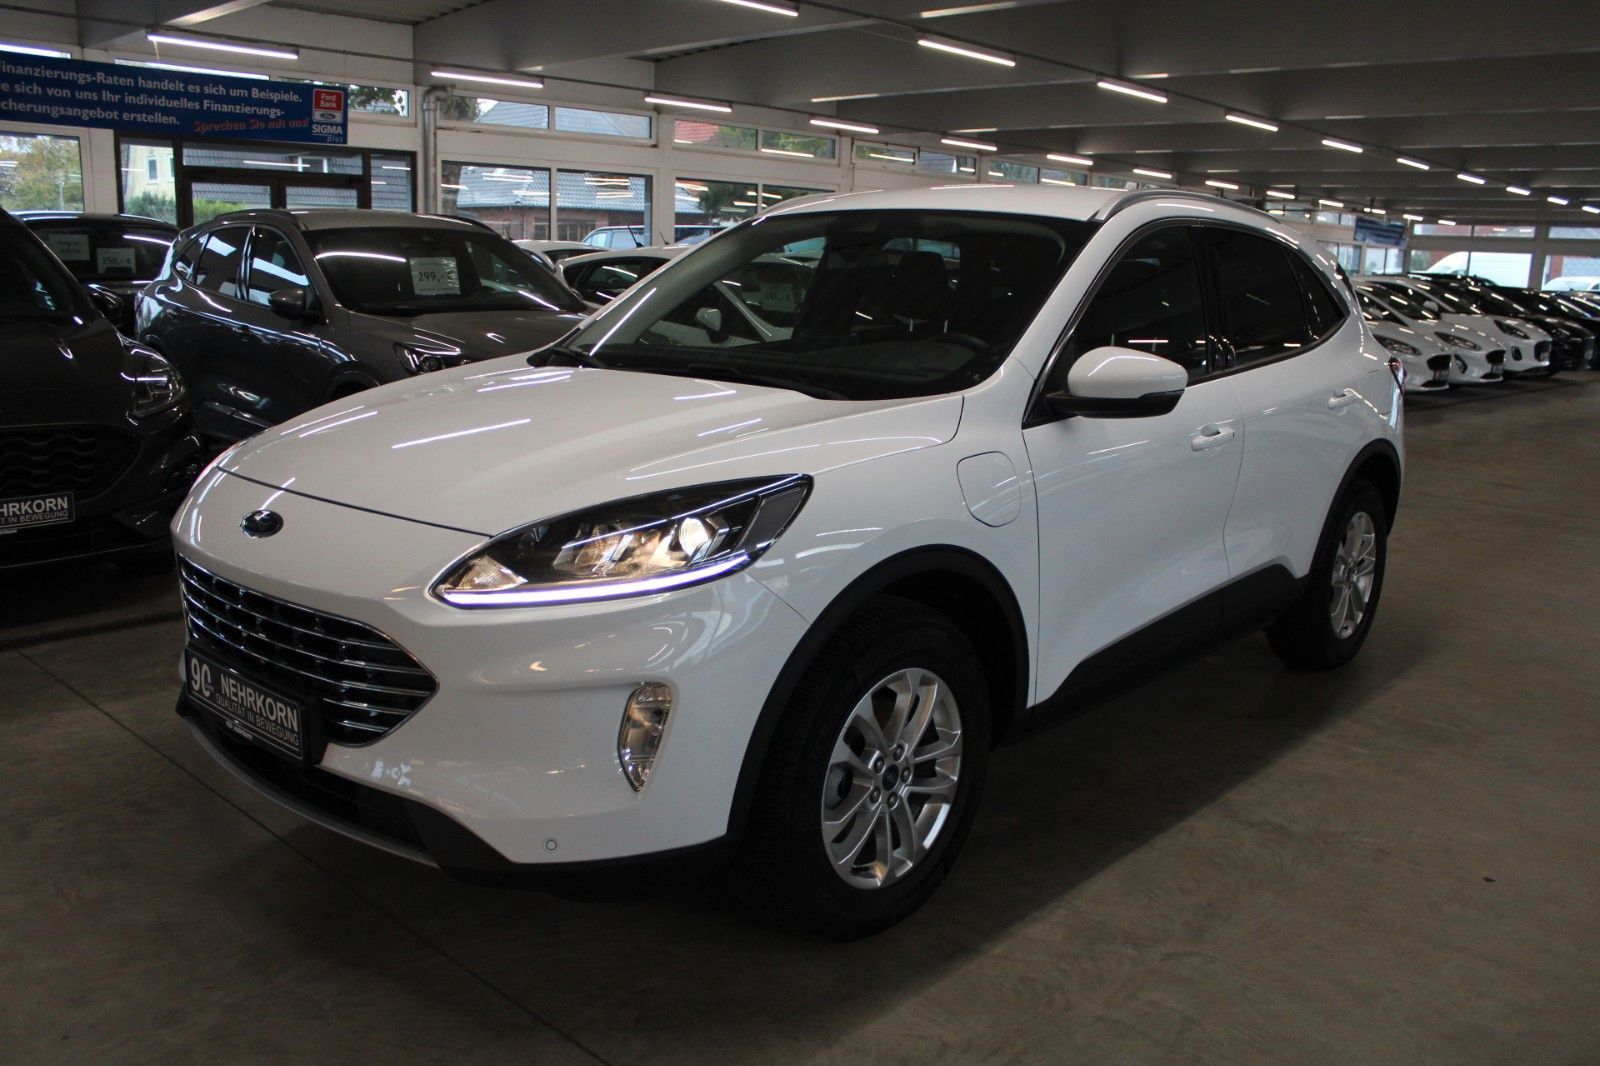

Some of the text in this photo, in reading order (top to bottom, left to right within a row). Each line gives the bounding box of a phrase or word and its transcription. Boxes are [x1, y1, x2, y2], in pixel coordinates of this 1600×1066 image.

[0, 61, 303, 103] inanzierungs-Raten handelt es sich um Beispiele.
[14, 82, 42, 95] sich
[47, 87, 71, 99] von
[75, 89, 99, 101] uns
[102, 90, 121, 103] Ihr
[125, 92, 200, 110] individuelles
[203, 99, 286, 119] Finanzierungs-
[320, 92, 337, 102] Ford
[320, 100, 337, 109] Bank
[122, 110, 180, 126] erstellen.
[311, 123, 343, 135] SIGMA
[20, 509, 69, 523] BEWEGUNG
[220, 673, 299, 732] NEHRKORN
[255, 714, 300, 746] BEWEGUNG
